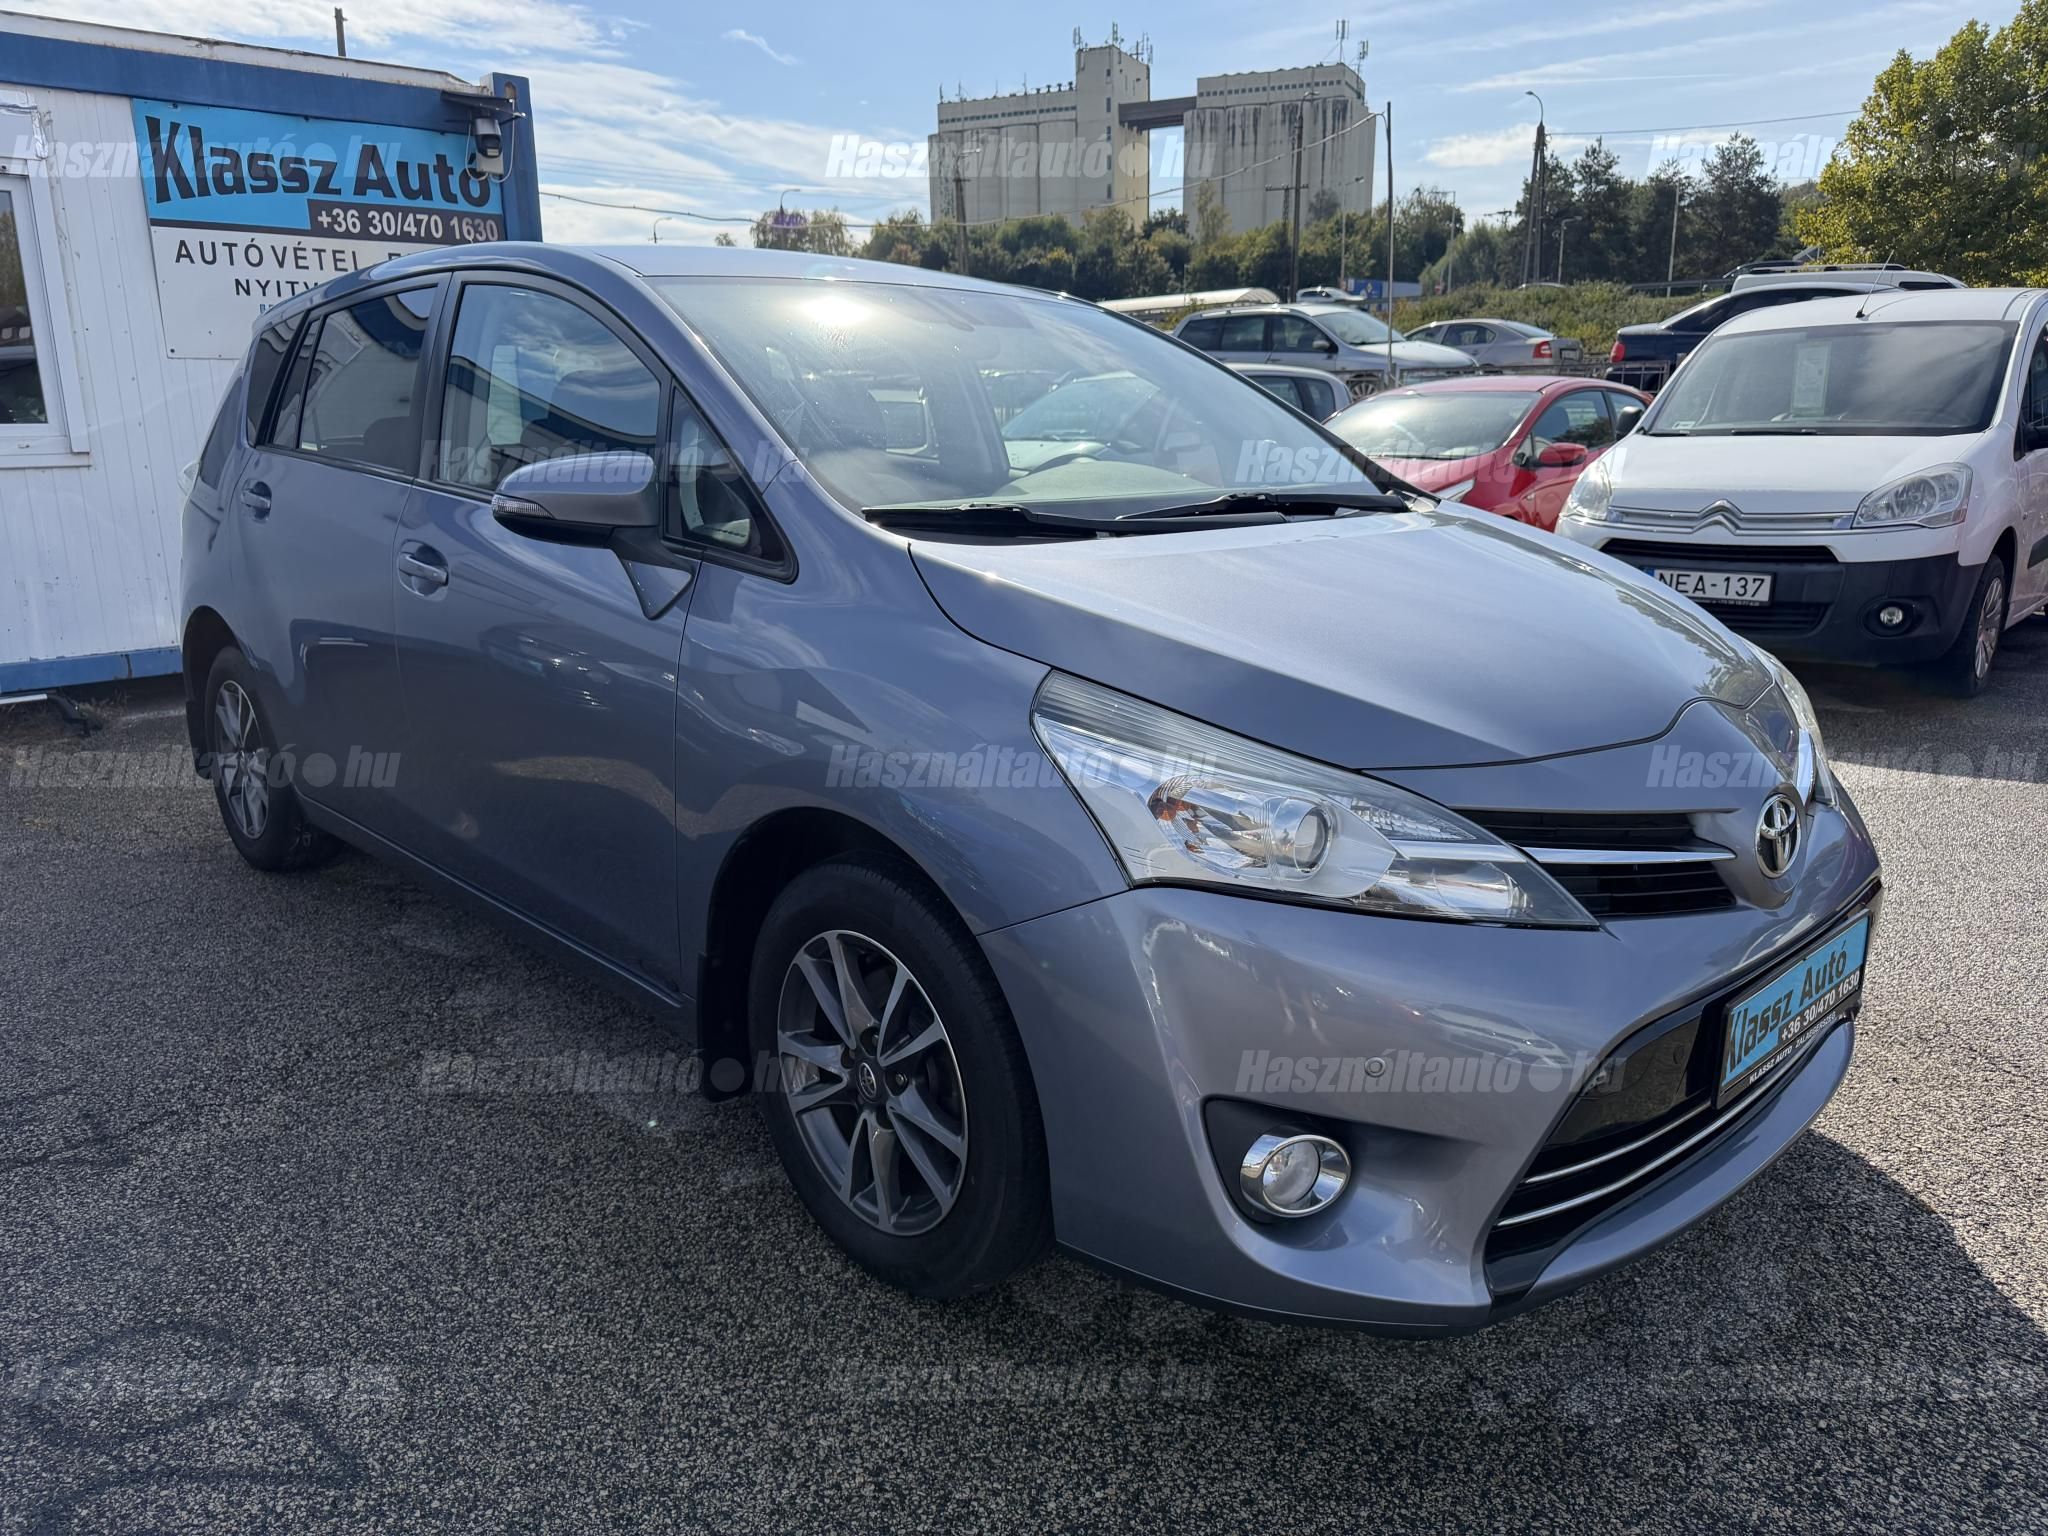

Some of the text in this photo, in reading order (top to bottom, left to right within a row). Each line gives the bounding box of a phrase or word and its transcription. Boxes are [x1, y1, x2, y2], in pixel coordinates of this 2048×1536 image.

[145, 116, 492, 208] Klassz Autó
[317, 208, 499, 243] +36 30/470 1630
[1658, 573, 1765, 598] NEA-137
[1722, 939, 1847, 1081] Klassz Autó
[1781, 970, 1860, 1041] +36 30/470 1630
[1749, 1060, 1775, 1085] KLASSZ
